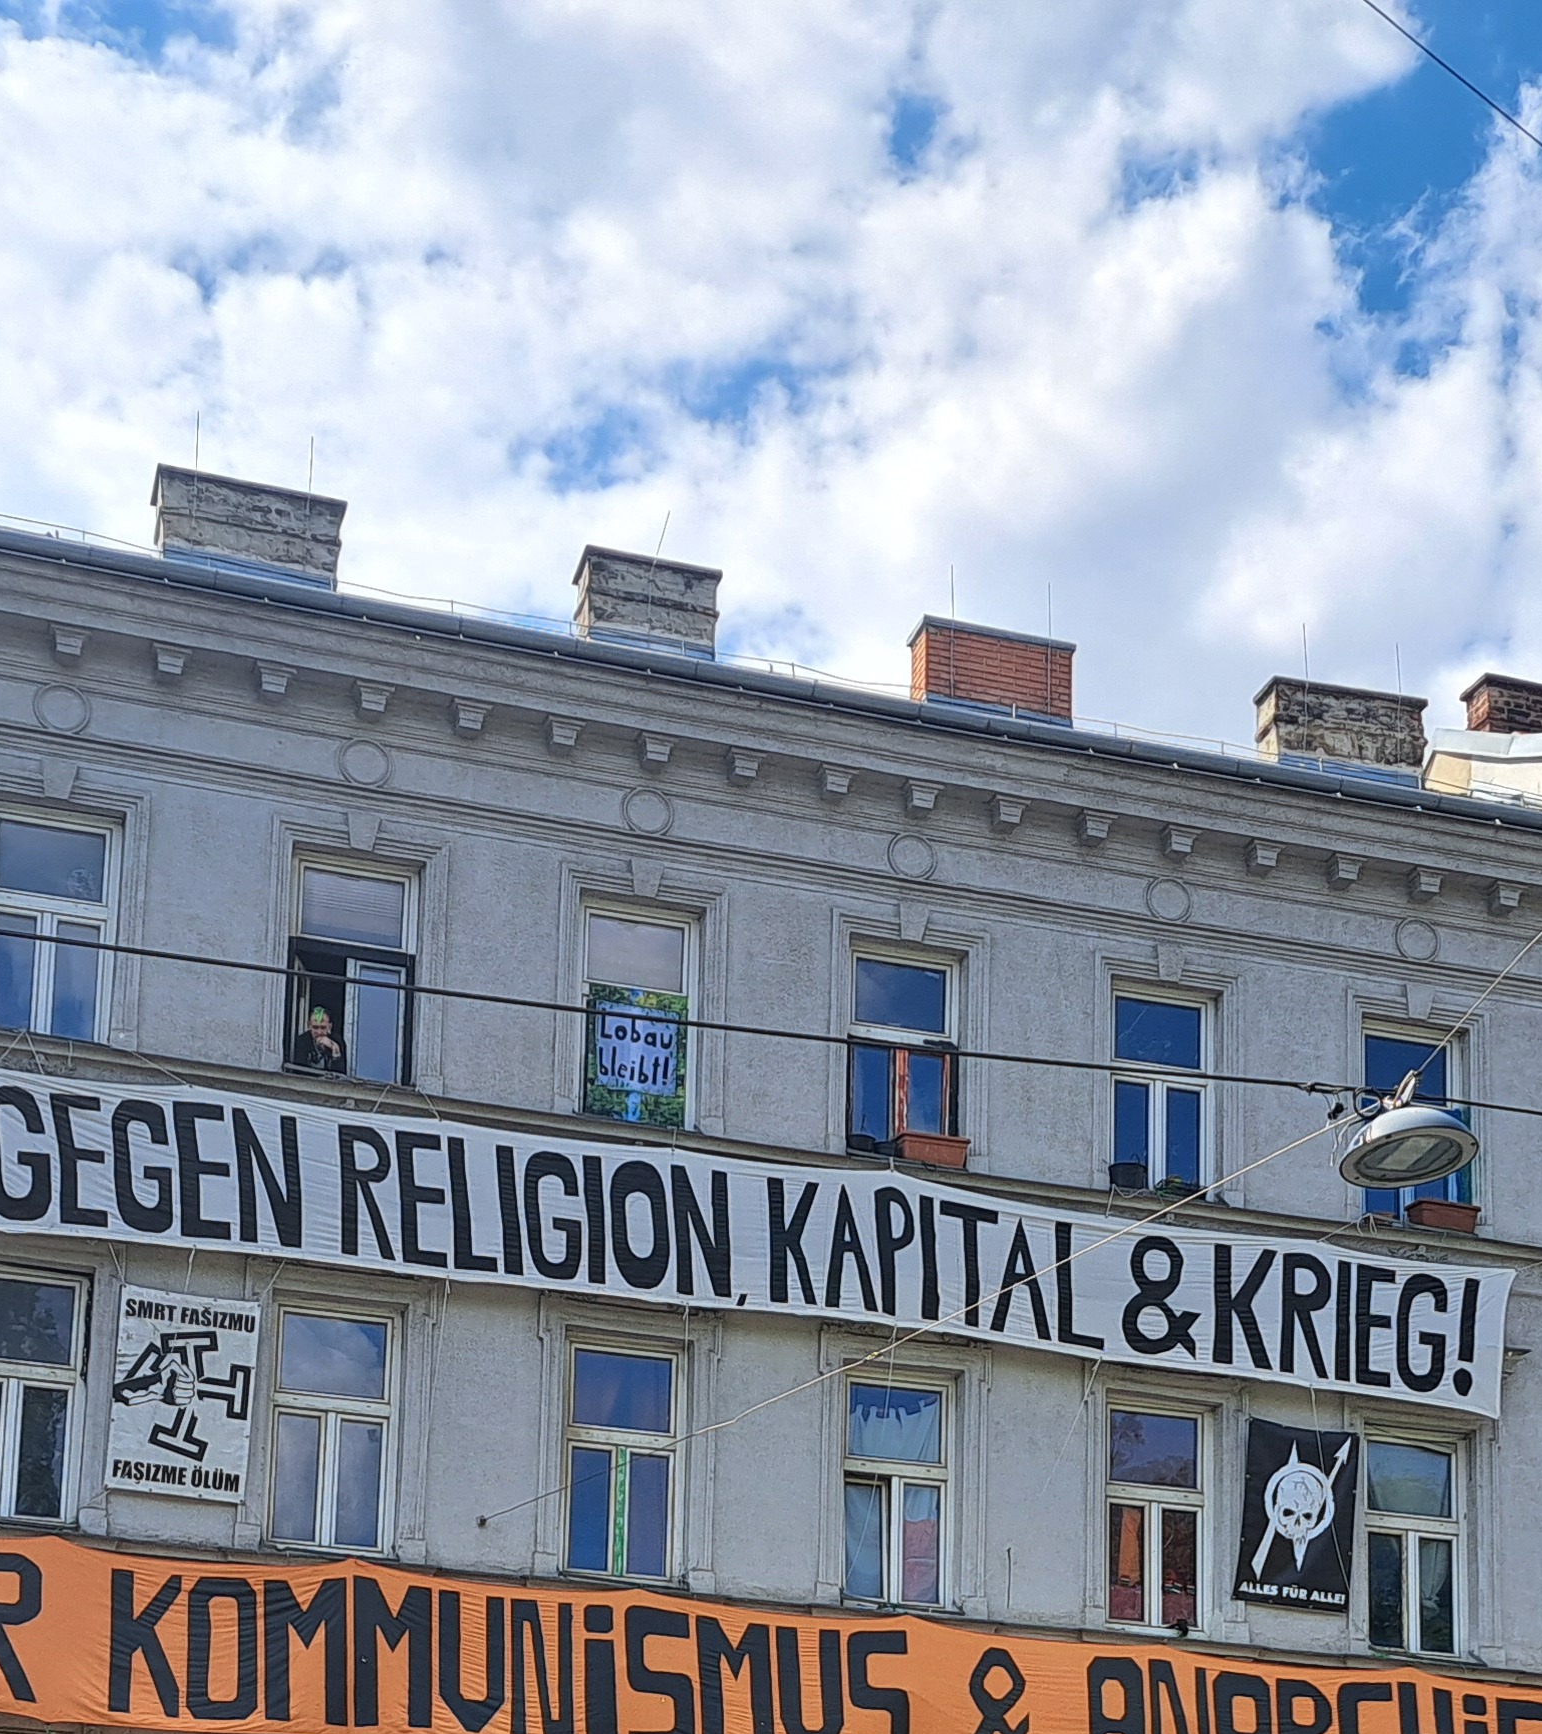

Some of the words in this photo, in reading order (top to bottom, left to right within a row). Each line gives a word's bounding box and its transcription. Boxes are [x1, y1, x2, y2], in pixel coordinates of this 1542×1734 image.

[600, 1008, 673, 1049] Lobau
[599, 1047, 670, 1085] bleibt!
[339, 1125, 747, 1306] RELIGION,
[767, 1177, 1105, 1350] KAPITAL
[1122, 1236, 1198, 1360] &
[1213, 1243, 1481, 1397] KRIEG!
[126, 1299, 177, 1322] SMRT
[180, 1306, 256, 1333] FAŠIZMU
[112, 1459, 187, 1484] FAŞIZME
[191, 1465, 240, 1493] ÖLÜM
[1238, 1581, 1279, 1596] ALLES
[1282, 1585, 1308, 1600] FÜR
[1310, 1590, 1346, 1605] ALLE!
